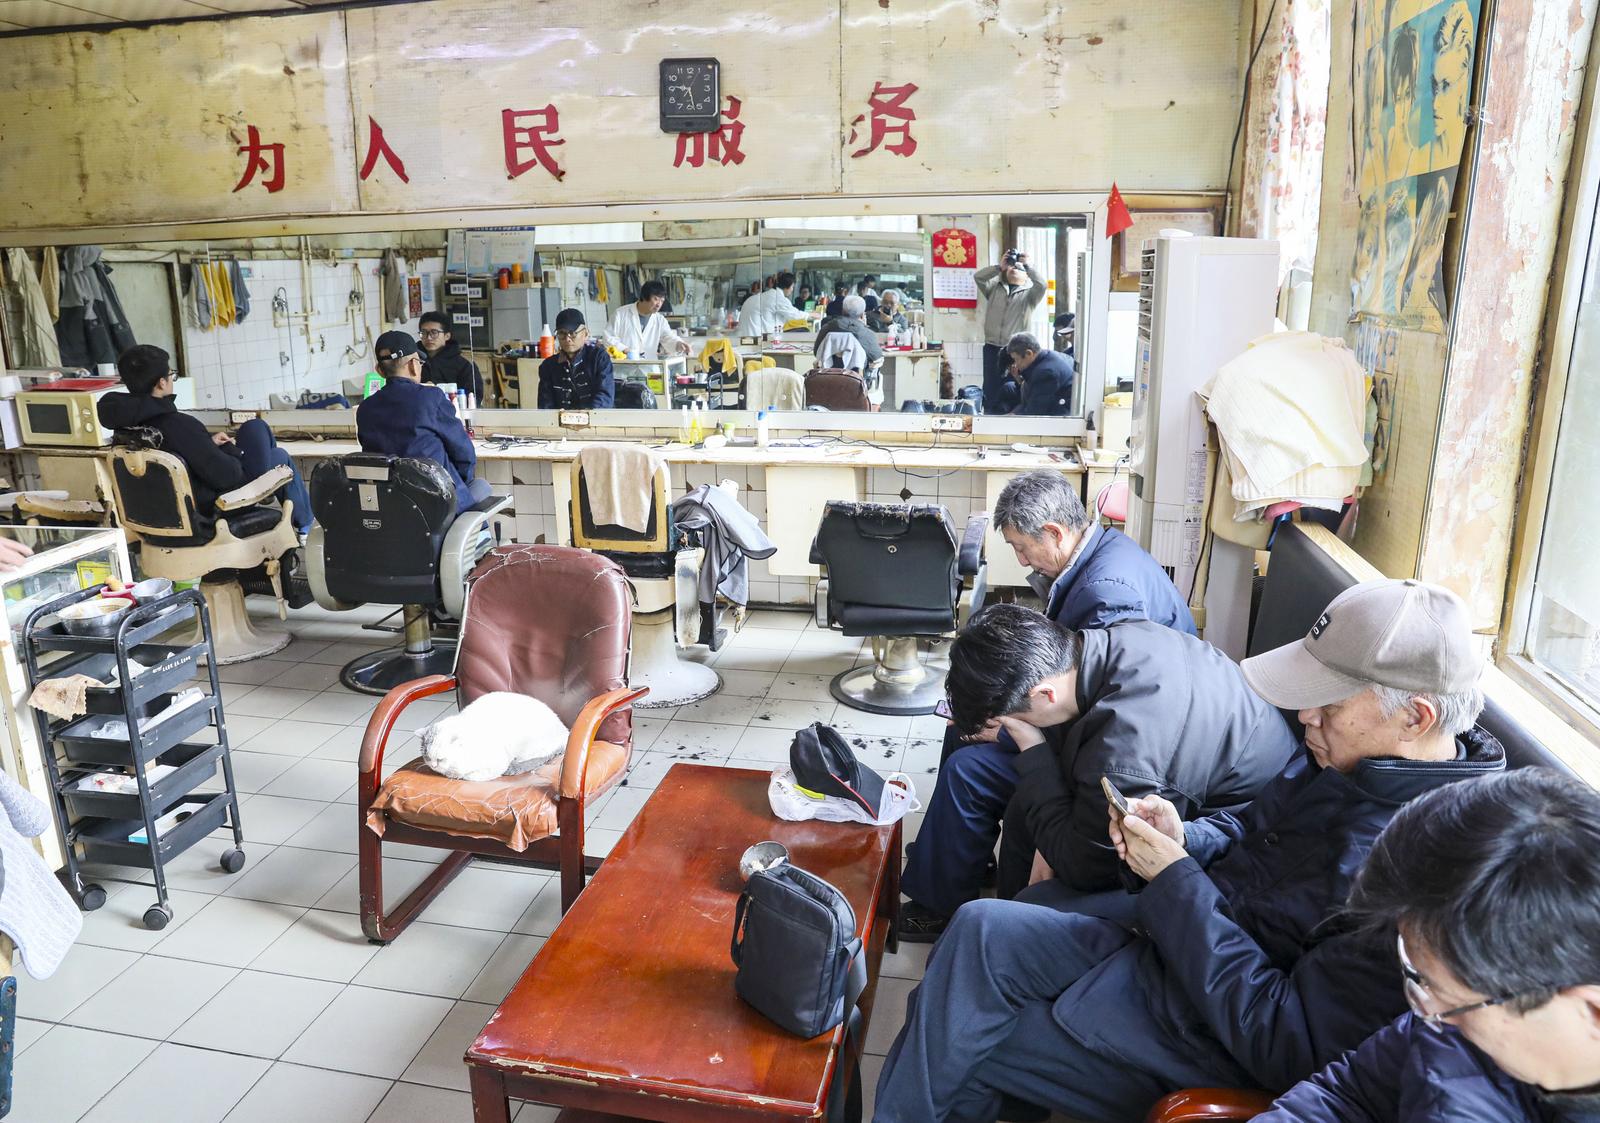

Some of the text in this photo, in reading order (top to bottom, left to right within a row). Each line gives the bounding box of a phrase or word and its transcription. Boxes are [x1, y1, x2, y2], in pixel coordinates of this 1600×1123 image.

[668, 74, 678, 82] 10
[703, 84, 711, 92] 3
[668, 96, 676, 104] 8
